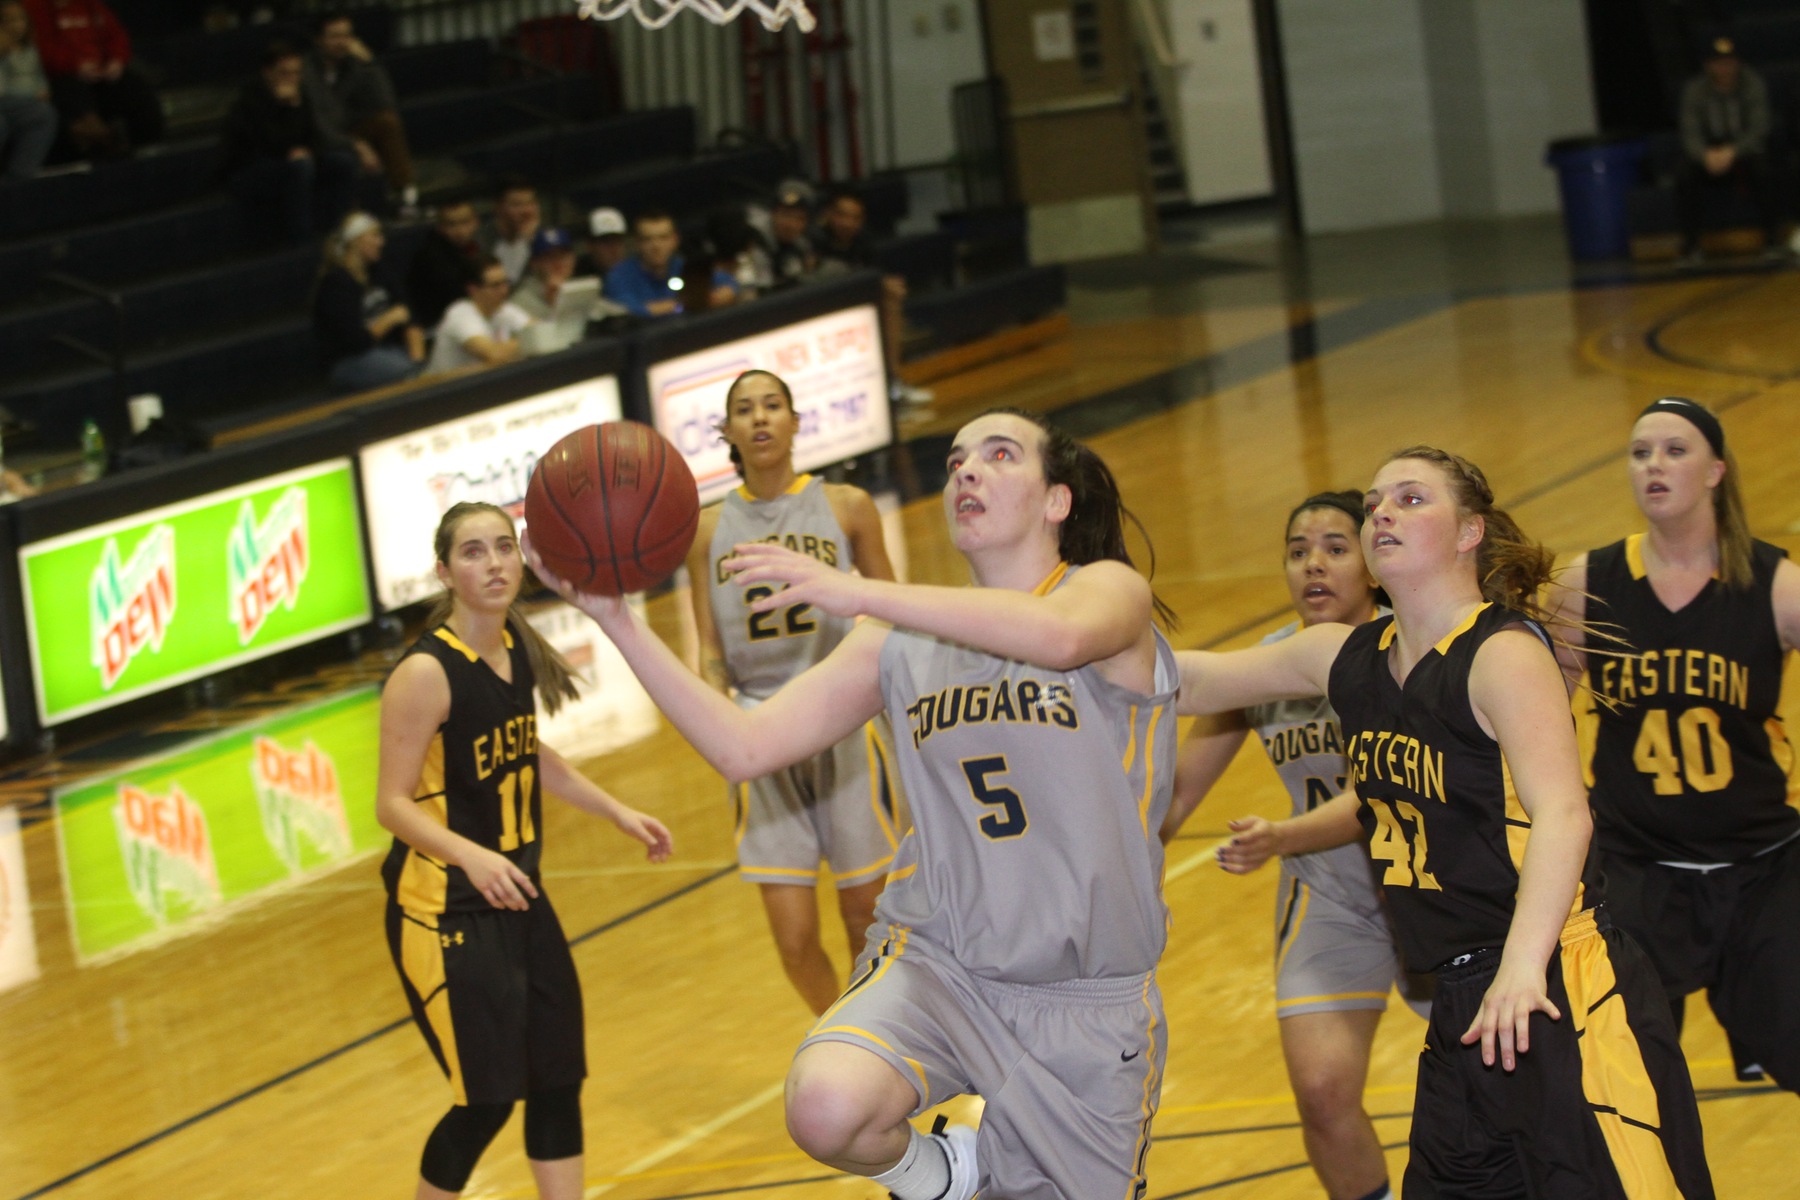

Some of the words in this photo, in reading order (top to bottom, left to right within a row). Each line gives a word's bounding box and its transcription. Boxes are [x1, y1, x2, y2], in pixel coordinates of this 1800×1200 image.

[716, 532, 838, 585] CARS
[744, 582, 817, 643] 22
[1602, 648, 1748, 710] EASTERN
[473, 714, 539, 781] EASTE
[1264, 721, 1344, 768] OUGA
[1632, 706, 1734, 795] 40
[959, 753, 1031, 842] 5
